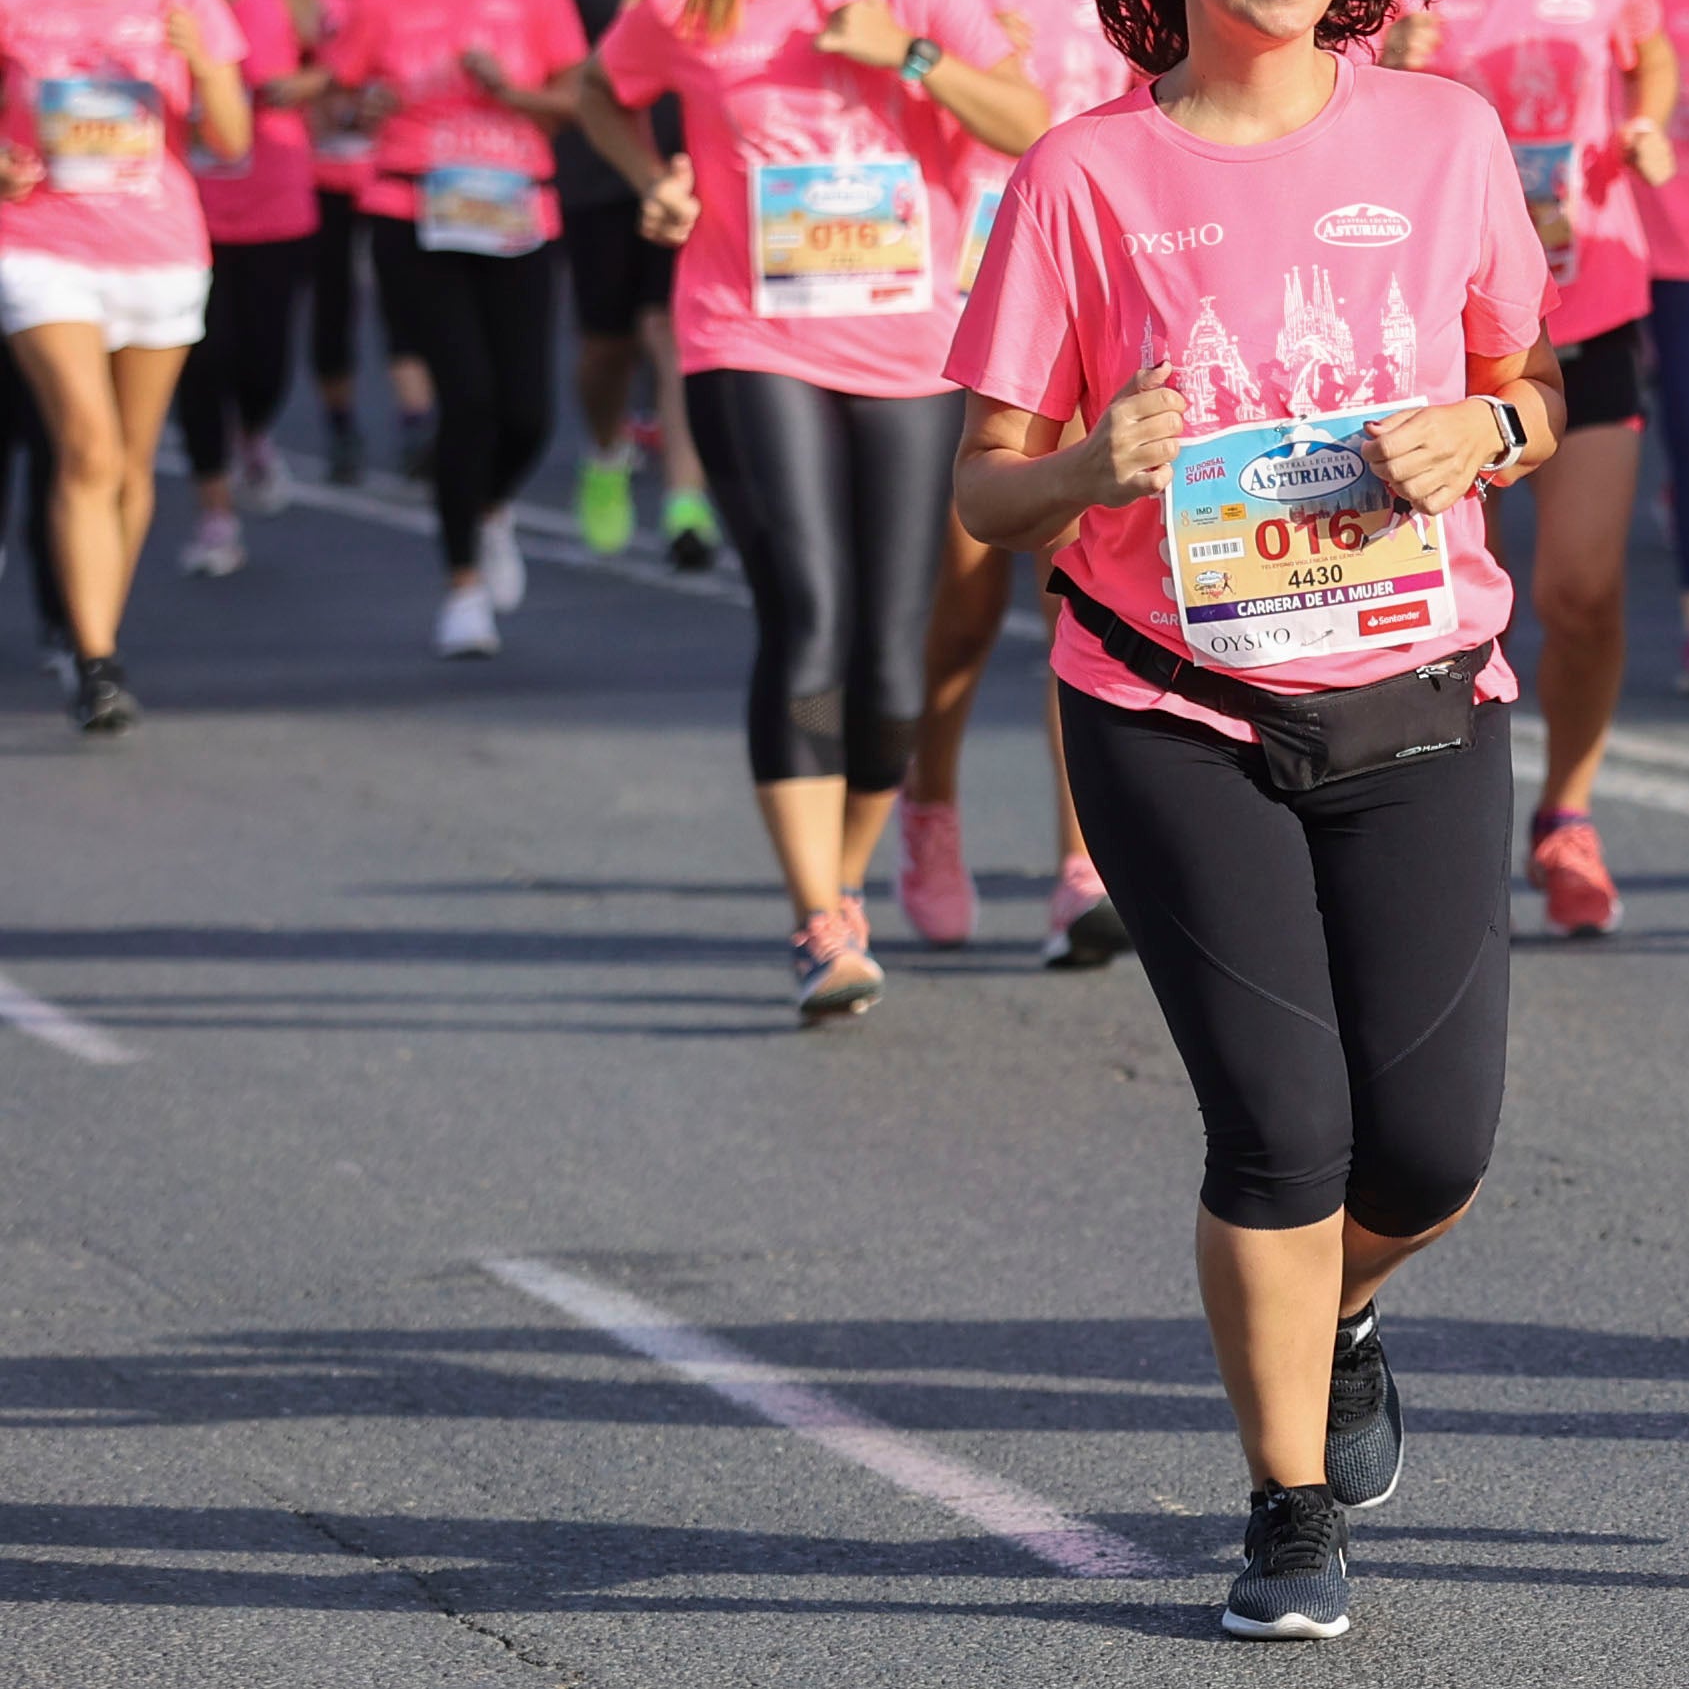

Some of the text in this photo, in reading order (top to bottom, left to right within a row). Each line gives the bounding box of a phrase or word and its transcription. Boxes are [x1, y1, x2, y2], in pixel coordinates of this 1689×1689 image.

[1120, 222, 1224, 257] OYSHO
[1320, 220, 1405, 238] ASTURIANA
[1185, 465, 1226, 486] SUMA
[1250, 463, 1357, 492] ASTURIANA
[1255, 509, 1364, 561] 016
[1288, 564, 1344, 589] 4430
[1237, 581, 1394, 617] CARRERA DE LA MUJER
[1378, 610, 1420, 627] Santander
